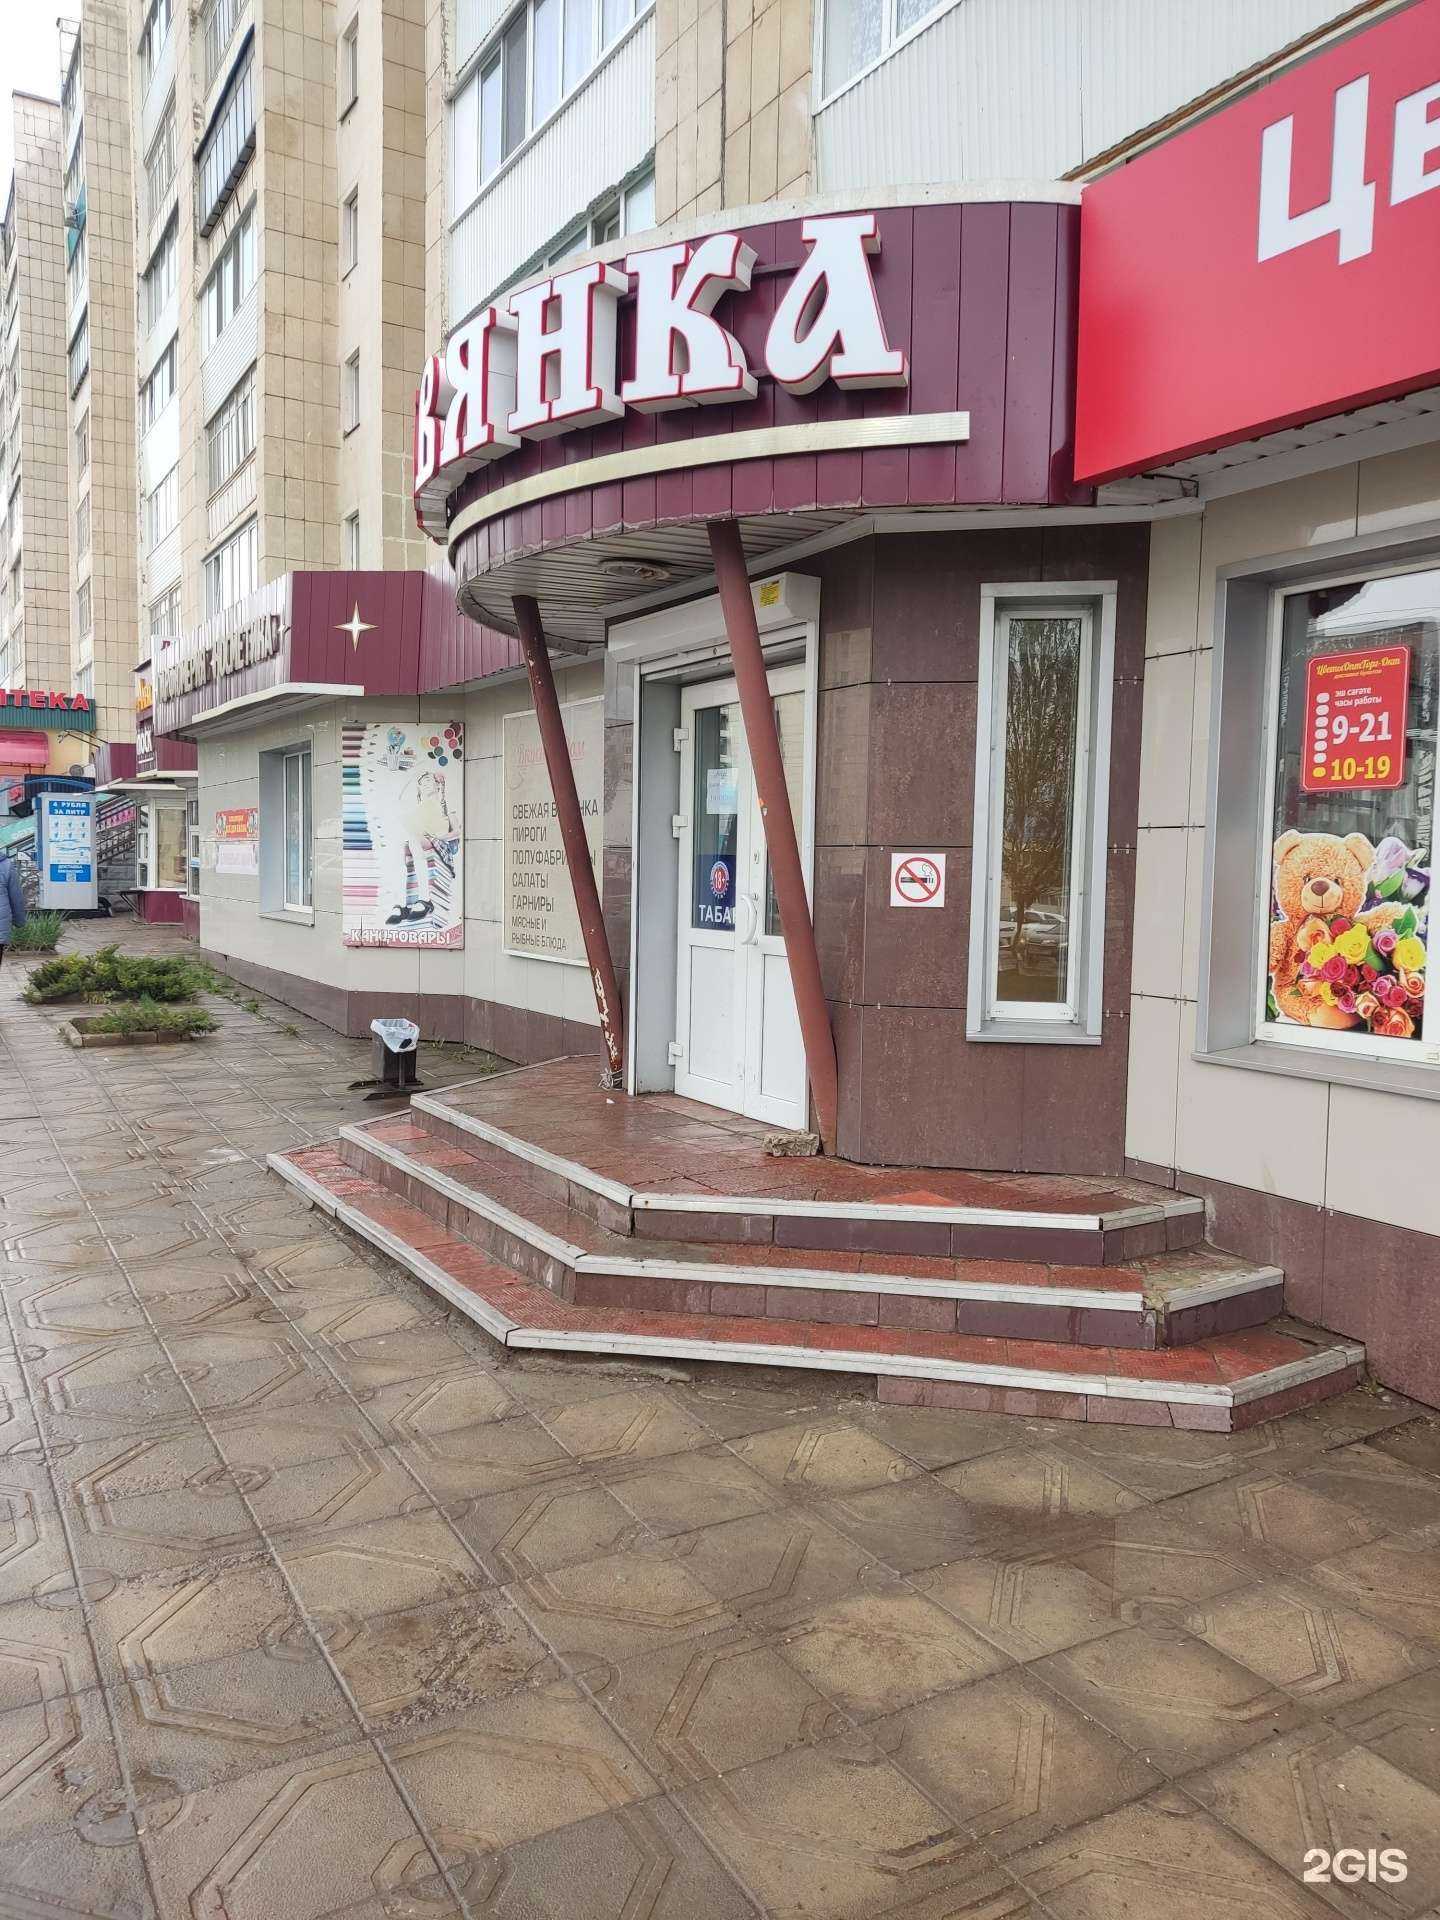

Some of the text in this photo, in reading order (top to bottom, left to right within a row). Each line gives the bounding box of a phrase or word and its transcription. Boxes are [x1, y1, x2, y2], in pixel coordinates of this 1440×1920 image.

[414, 213, 909, 508] ВЯНКА
[1335, 696, 1382, 707] часы работы
[1332, 711, 1392, 745] 9-21
[1331, 755, 1391, 781] 10-19
[512, 803, 549, 819] СВЕЖАЯ
[512, 826, 547, 842] ПИРОГИ
[512, 849, 596, 866] ПОЛУФАБРИЫ
[512, 872, 549, 888] САЛАТЫ
[714, 871, 726, 890] 18+
[512, 894, 554, 912] ГАРНИРЫ
[511, 916, 547, 932] МЯСНЫЕ И
[511, 932, 567, 951] РЫБНЫЕ БЛЮДА
